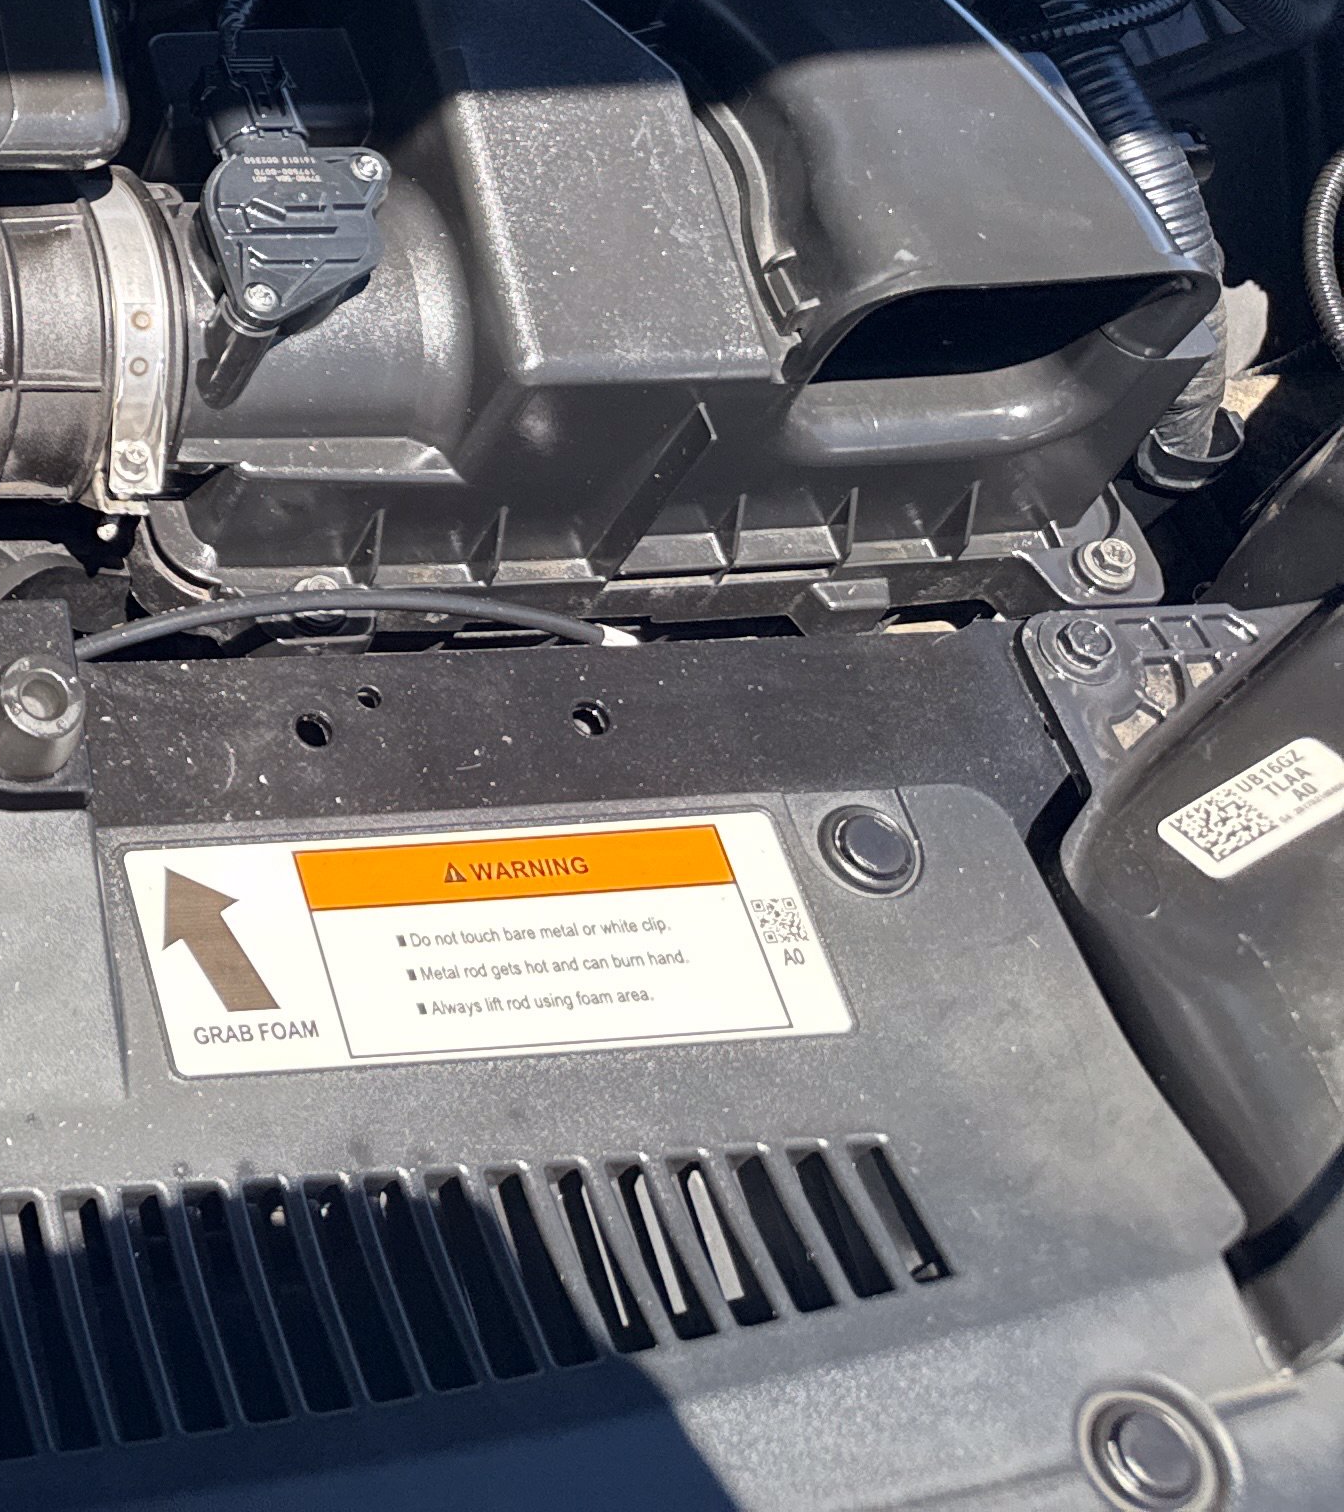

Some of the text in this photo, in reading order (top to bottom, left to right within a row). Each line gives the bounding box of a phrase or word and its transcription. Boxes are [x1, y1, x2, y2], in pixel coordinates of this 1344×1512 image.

[1234, 748, 1304, 793] UB16GZ
[1261, 765, 1312, 797] TLAA
[1291, 781, 1318, 801] A0
[468, 856, 589, 881] WARNING
[410, 917, 671, 947] Do not touch bare metal or white clip.
[419, 949, 690, 981] Metal rod gets hot and can burn hand.
[784, 948, 806, 967] A0
[431, 989, 655, 1017] Always lift rod using foam area.
[193, 1020, 320, 1045] GRAB FOAM
